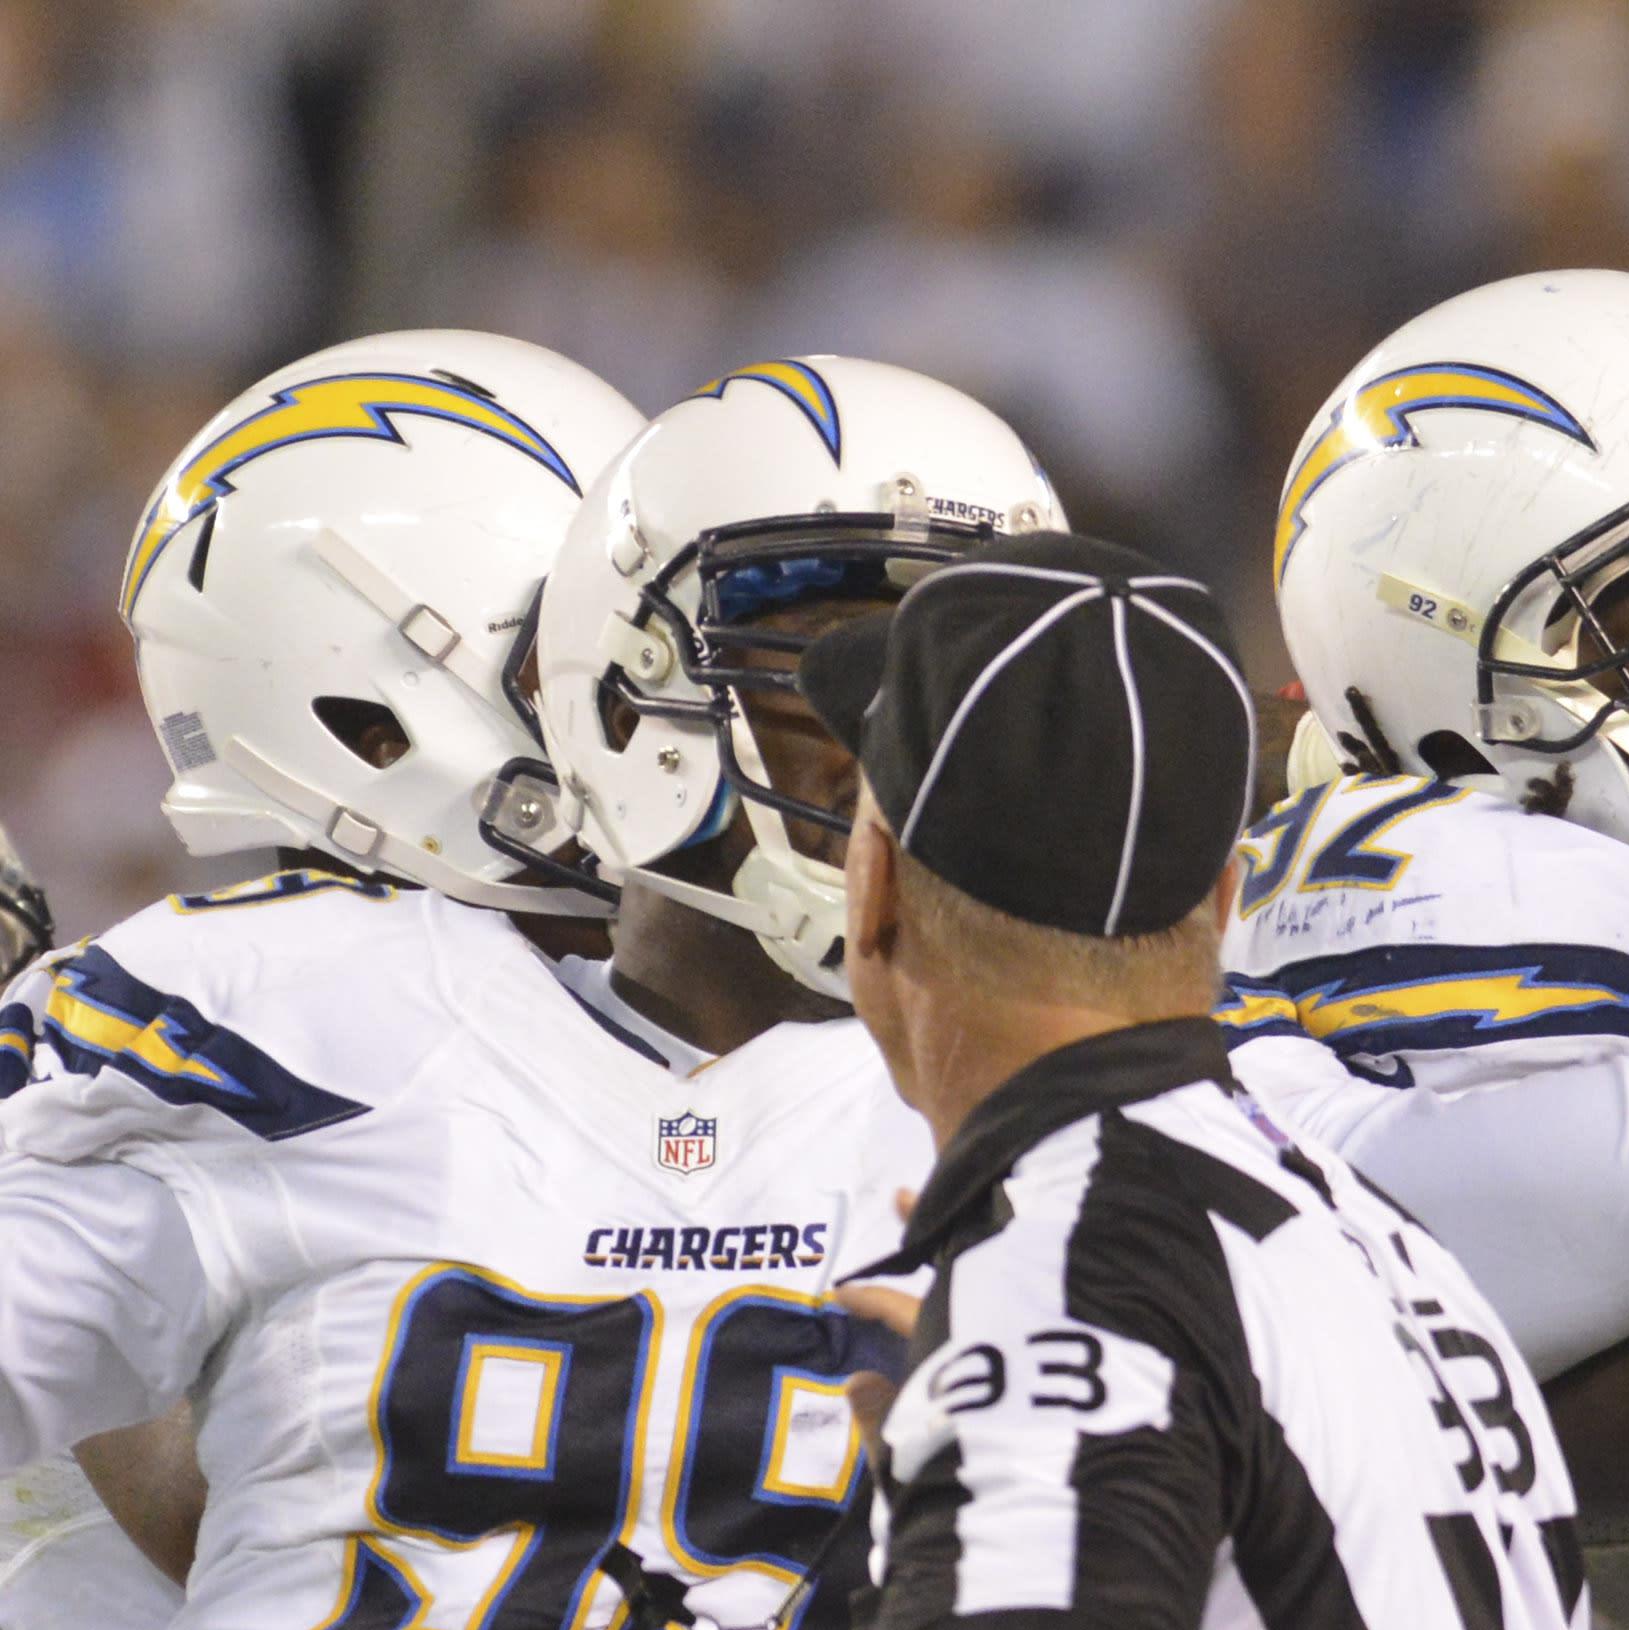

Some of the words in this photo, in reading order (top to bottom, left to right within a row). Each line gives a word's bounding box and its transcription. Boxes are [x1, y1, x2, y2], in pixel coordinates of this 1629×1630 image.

[487, 616, 525, 633] Ridde
[1408, 593, 1438, 620] 92
[1234, 772, 1478, 923] 92
[664, 1138, 711, 1168] NFL
[583, 1223, 827, 1271] CHARGERS
[926, 1327, 1109, 1417] 93
